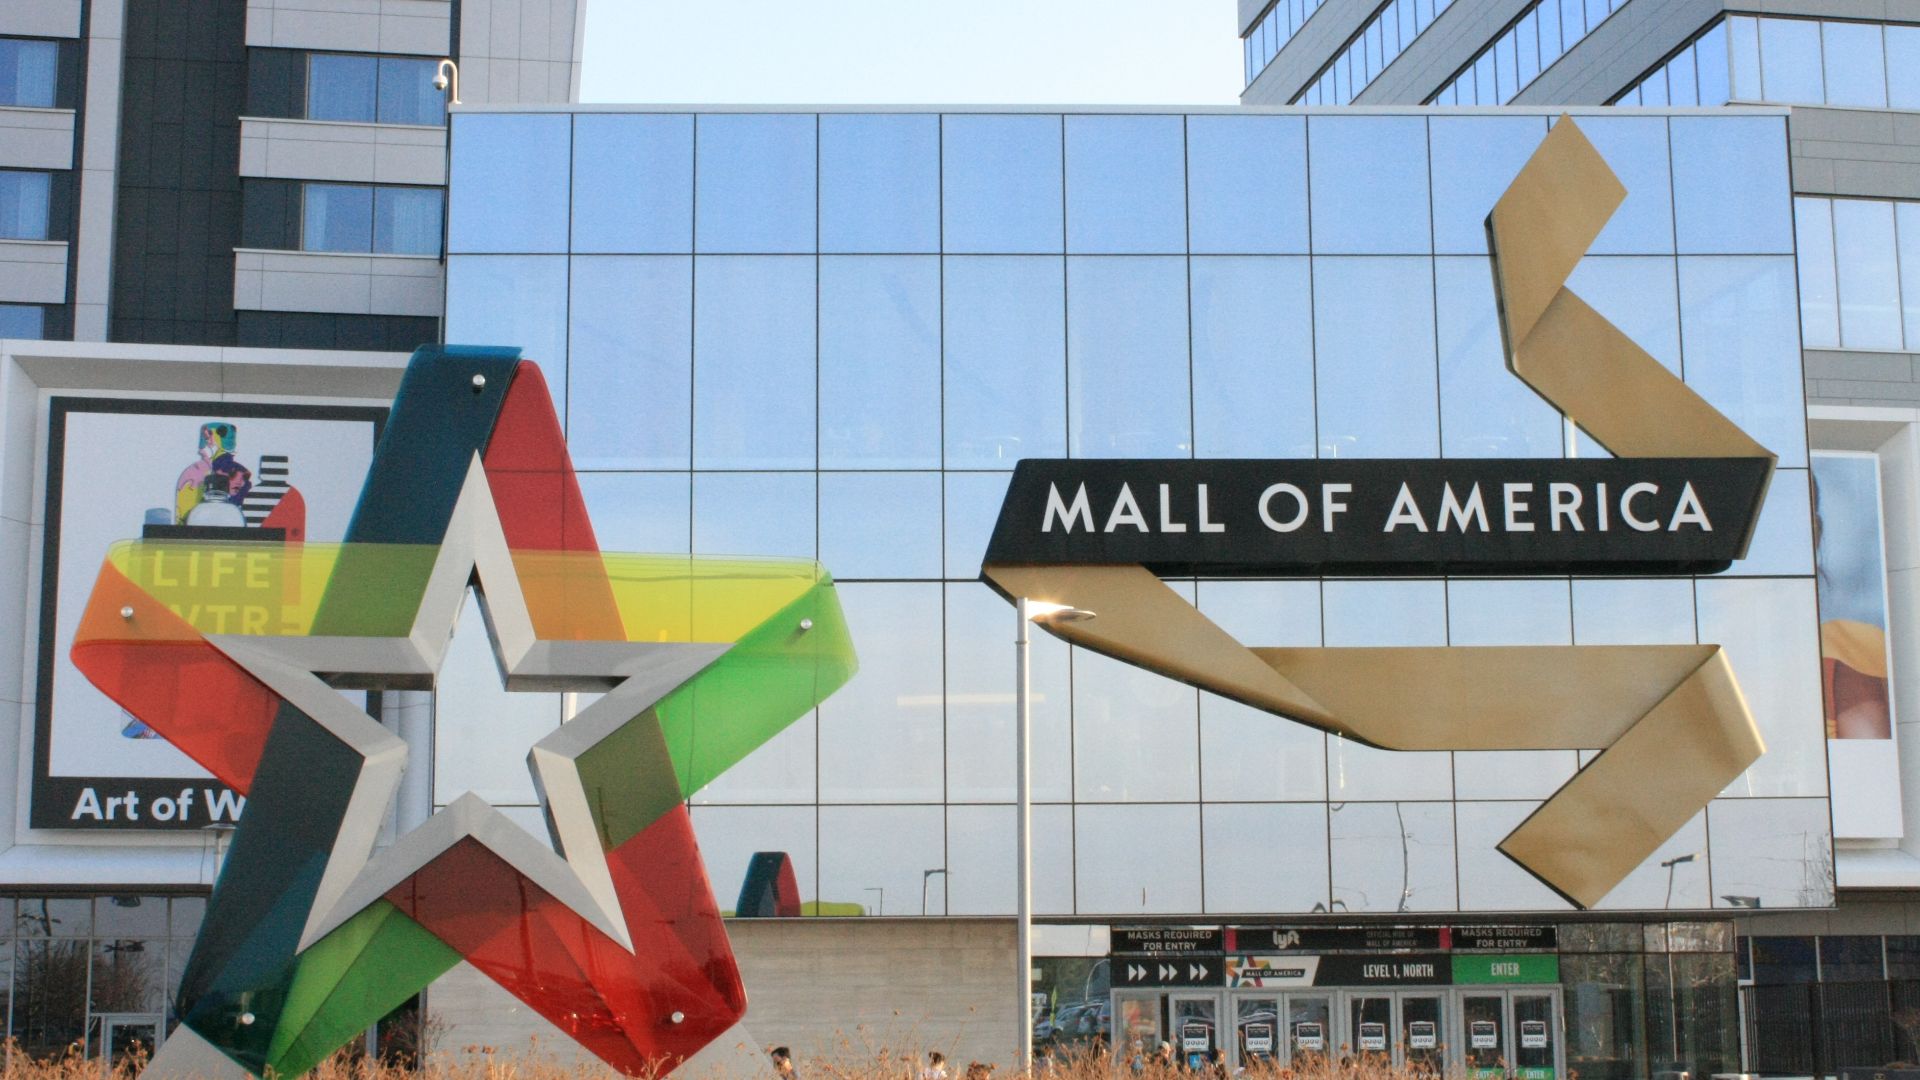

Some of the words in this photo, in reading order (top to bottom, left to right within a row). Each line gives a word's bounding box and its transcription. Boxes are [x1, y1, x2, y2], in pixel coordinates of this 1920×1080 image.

[1041, 481, 1225, 534] MALL
[1258, 481, 1353, 534] OF
[1384, 481, 1713, 533] AMERICA
[153, 550, 271, 588] LIFE
[71, 787, 139, 821] Art
[151, 788, 194, 821] of
[1127, 931, 1161, 940] MASKS
[1163, 930, 1212, 940] REQUIRED
[1461, 928, 1493, 937] MASKS
[1496, 928, 1542, 937] REQUIRED
[1143, 942, 1162, 951] FOR
[1165, 942, 1197, 951] ENTRY
[1476, 939, 1495, 948] FOR
[1497, 939, 1528, 948] ENTRY
[1363, 963, 1391, 978] LEVEL
[1392, 963, 1400, 979] 1,
[1403, 963, 1434, 977] NORTH
[1490, 962, 1520, 976] ENTER
